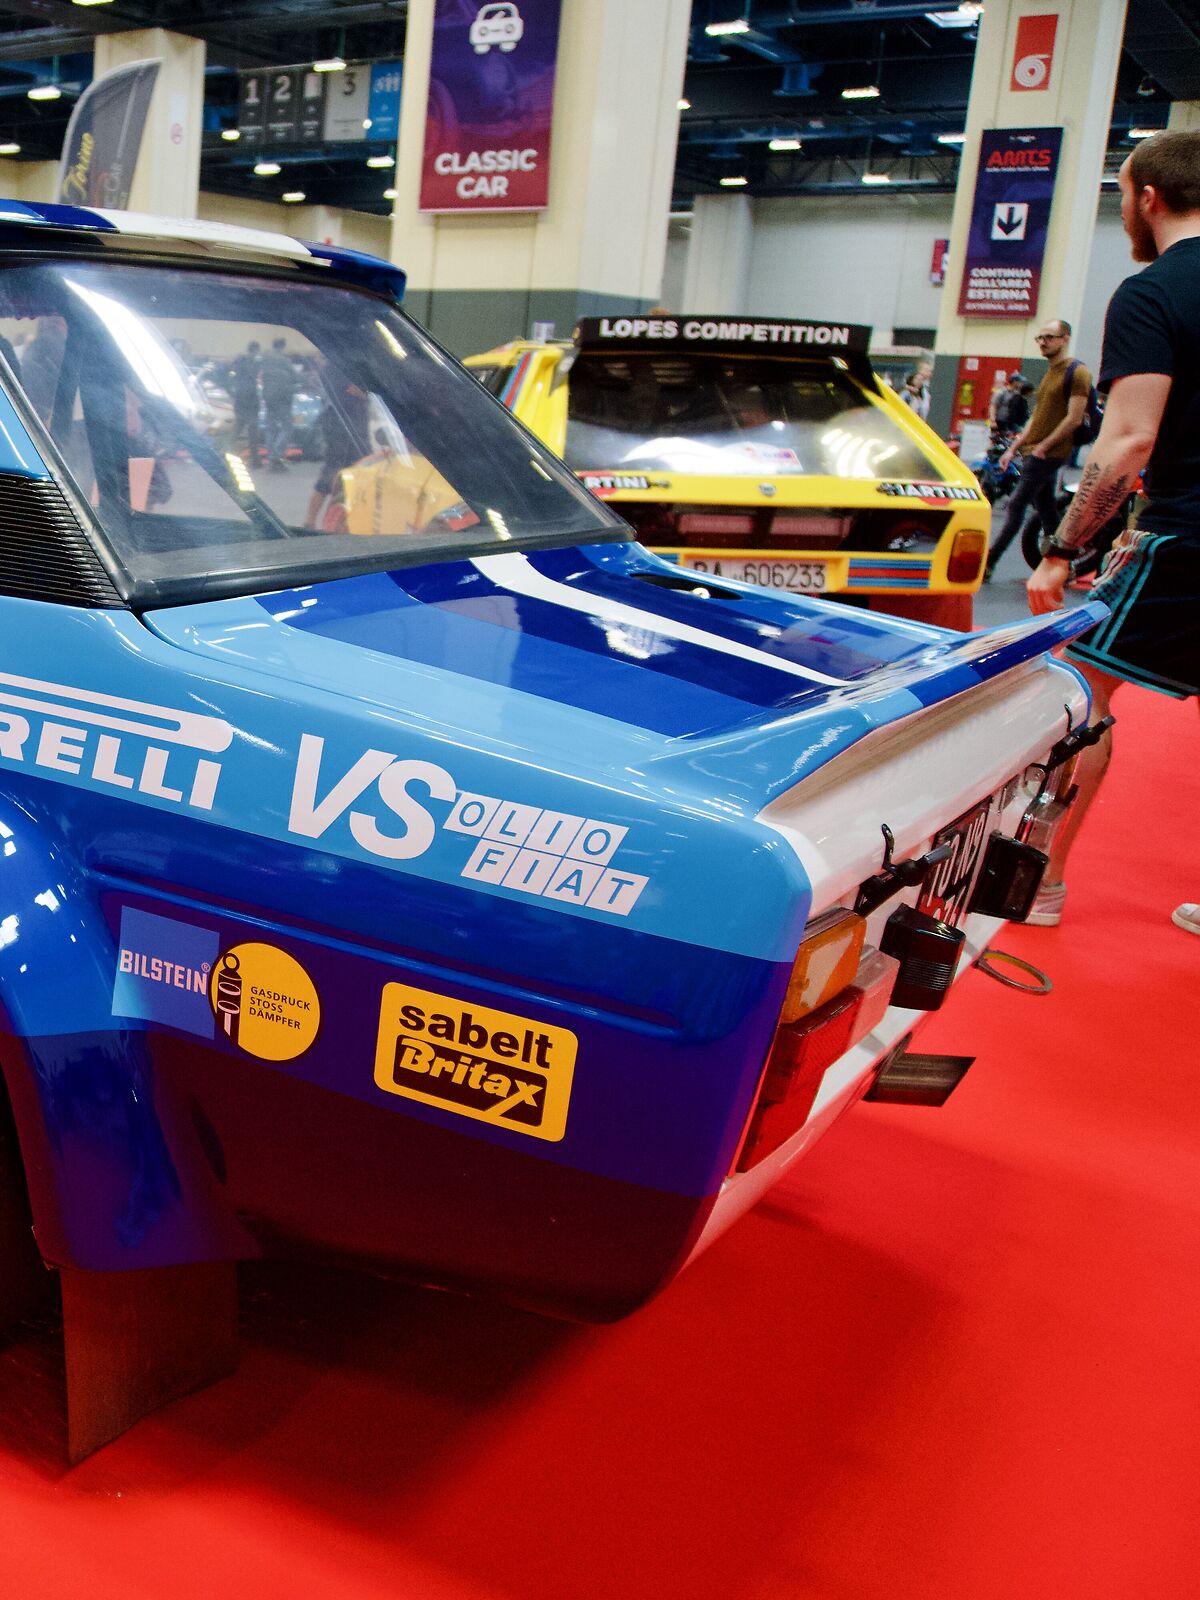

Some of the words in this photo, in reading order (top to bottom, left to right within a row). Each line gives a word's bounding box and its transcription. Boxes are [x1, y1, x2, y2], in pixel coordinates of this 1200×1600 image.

[245, 78, 259, 104] 1
[273, 75, 291, 102] 2
[342, 73, 356, 96] 3
[434, 149, 538, 175] CLASSIC
[456, 175, 509, 199] CAR
[600, 319, 678, 339] LOPES
[683, 321, 850, 345] COMPETITION
[584, 476, 648, 489] RTINI
[744, 563, 826, 588] 606233
[288, 733, 457, 860] VS
[458, 801, 612, 856] OLIO
[475, 848, 636, 905] FIAT
[119, 949, 208, 995] BILSTEIN
[250, 986, 311, 1011] GASDRUCK
[250, 996, 284, 1013] STOSS
[249, 1007, 302, 1030] DÄMPFER
[399, 1005, 553, 1070] sabelt
[400, 1037, 544, 1114] Britax
